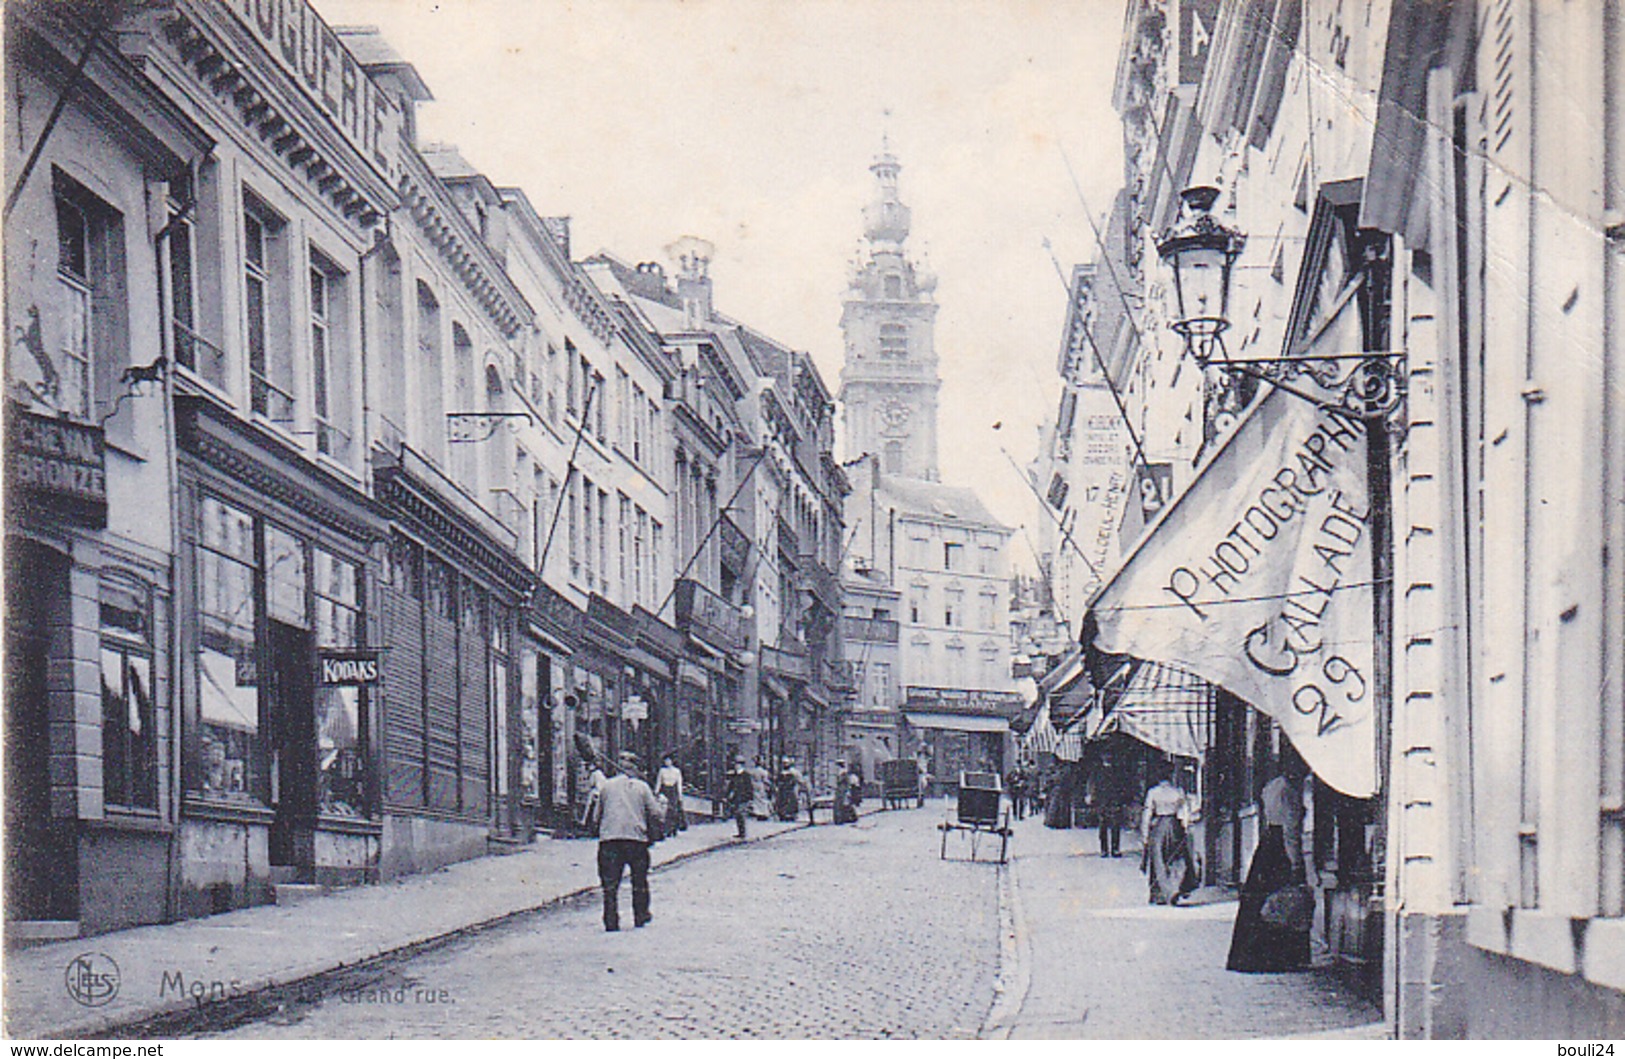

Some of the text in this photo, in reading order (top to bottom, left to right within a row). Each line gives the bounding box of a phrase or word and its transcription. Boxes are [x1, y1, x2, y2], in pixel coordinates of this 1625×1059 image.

[18, 454, 104, 497] BRONZE
[322, 658, 378, 683] KODAKS
[1292, 655, 1366, 737] 29
